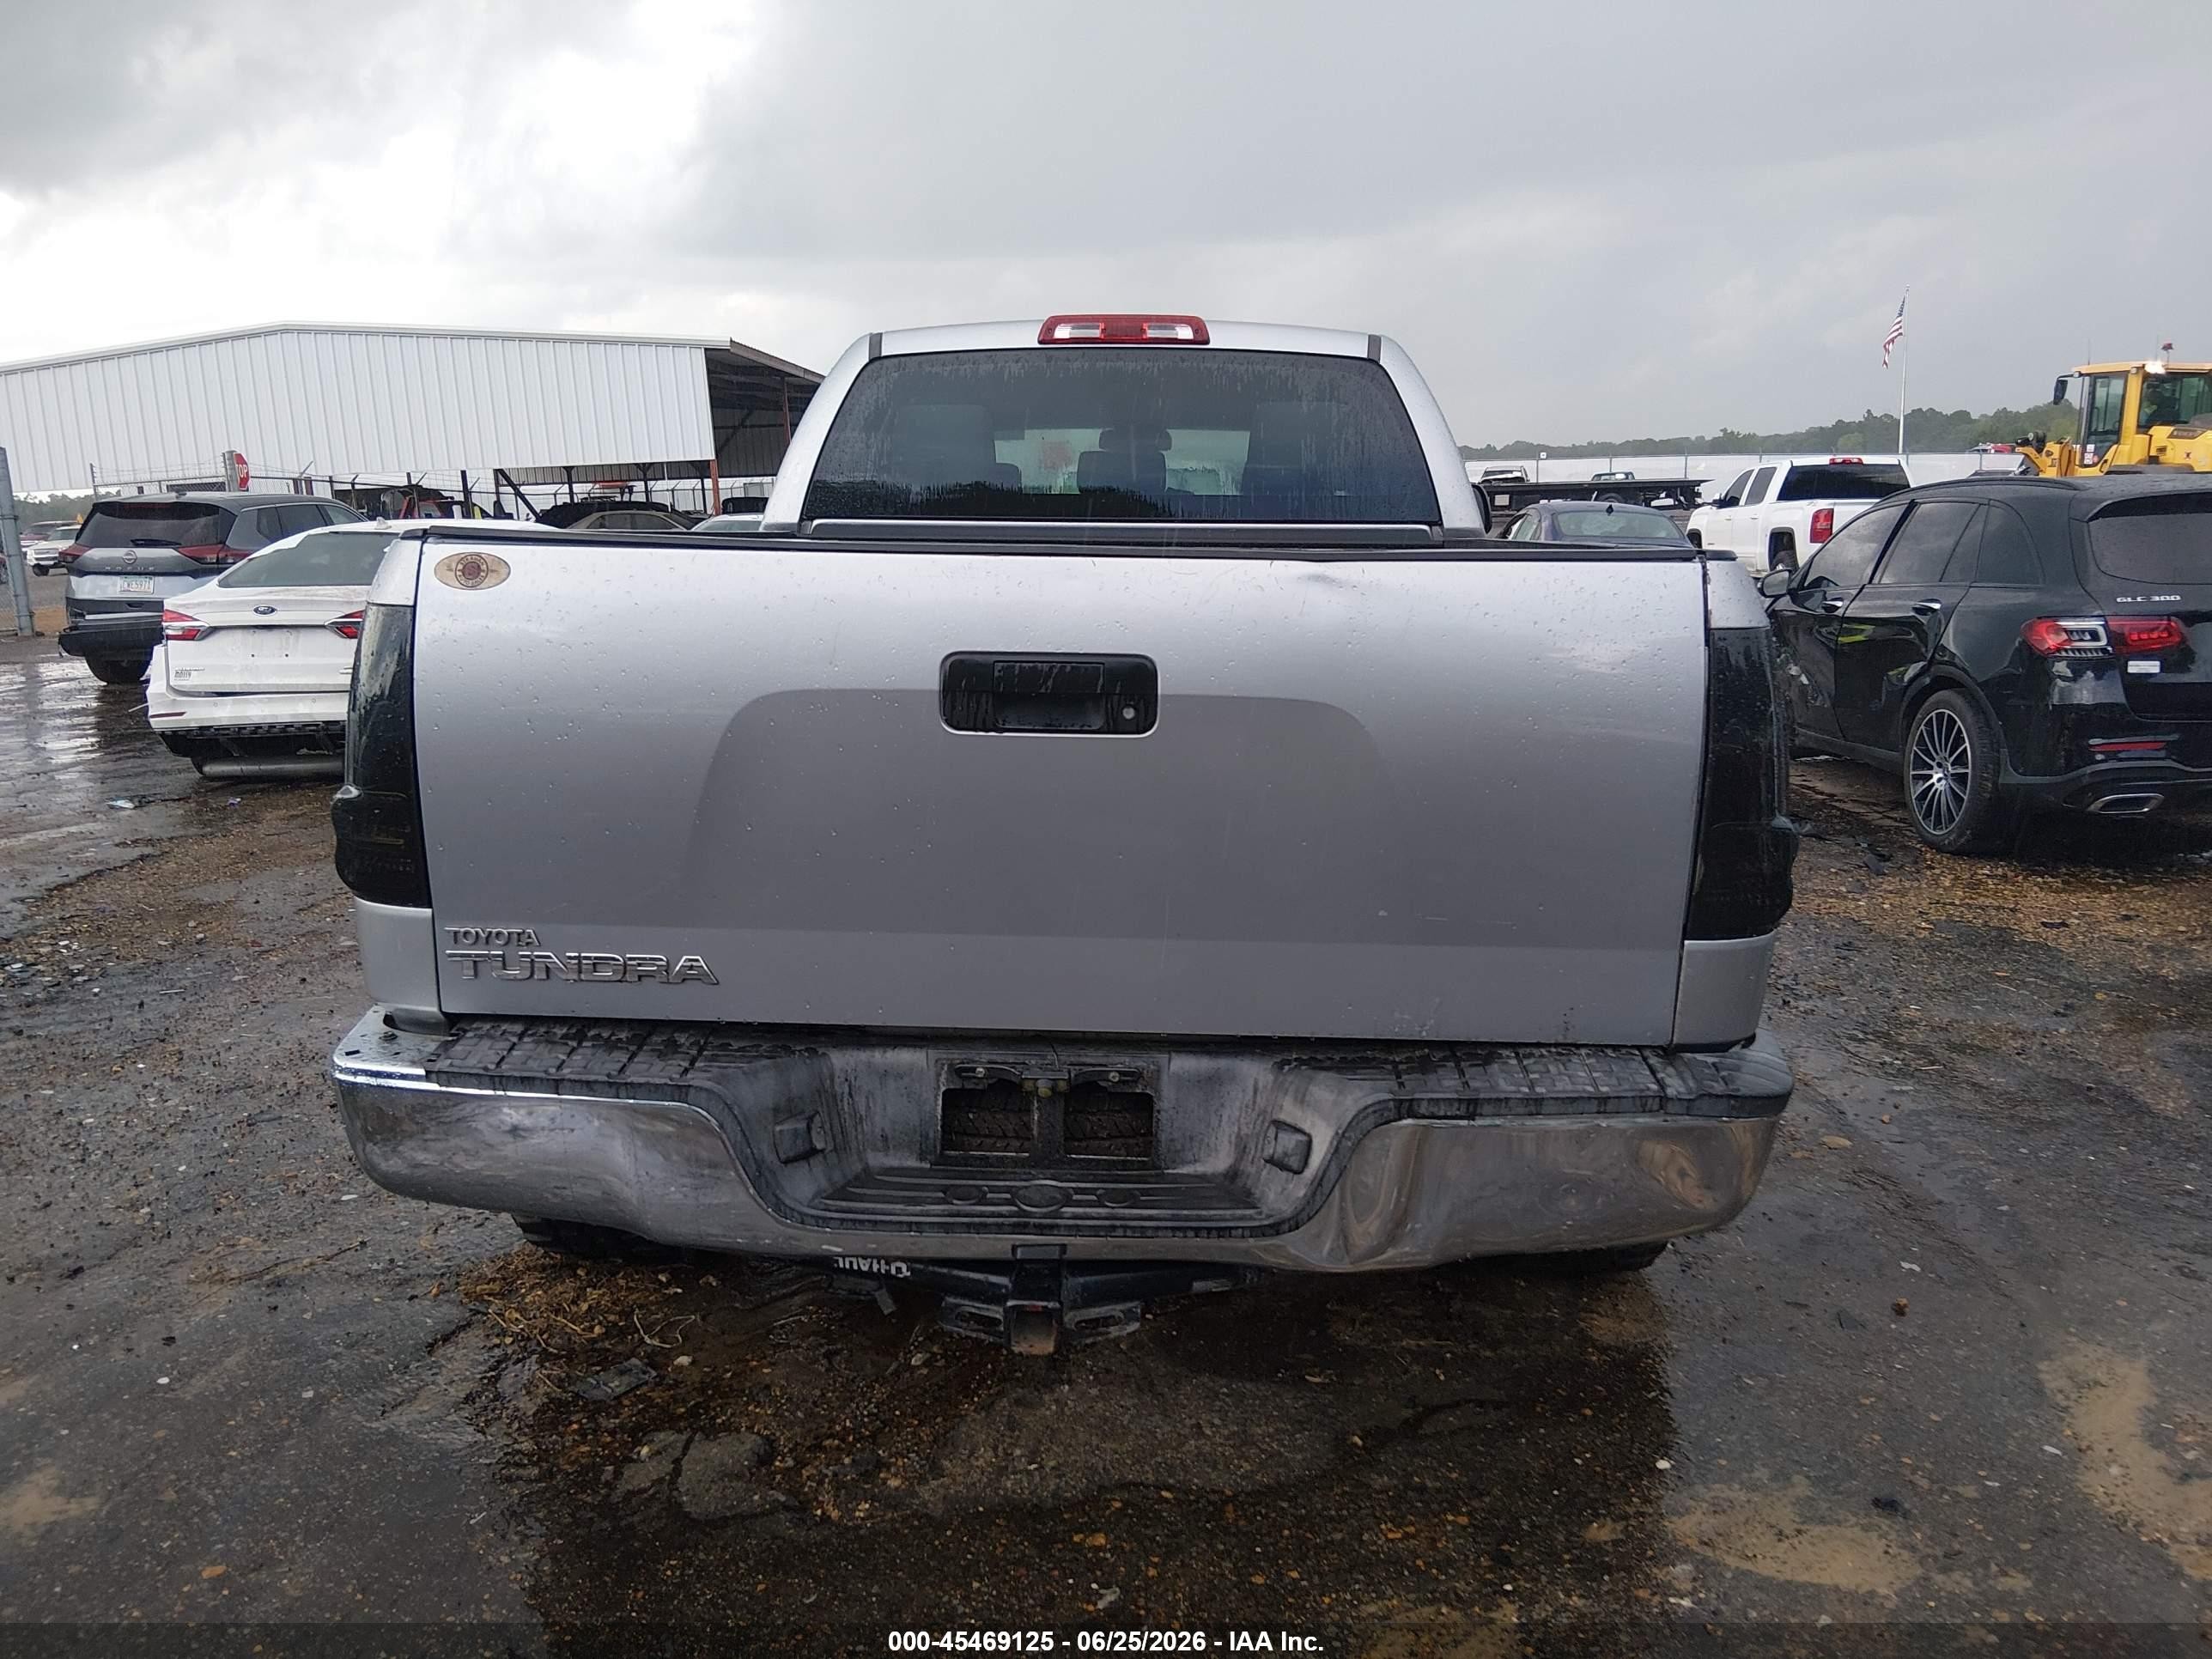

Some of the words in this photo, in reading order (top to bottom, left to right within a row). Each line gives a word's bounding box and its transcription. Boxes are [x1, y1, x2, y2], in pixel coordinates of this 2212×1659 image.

[235, 464, 248, 478] TOP
[444, 927, 541, 947] TOYOTA
[445, 950, 720, 986] TUNDRA
[833, 1256, 911, 1278] U-HAUL
